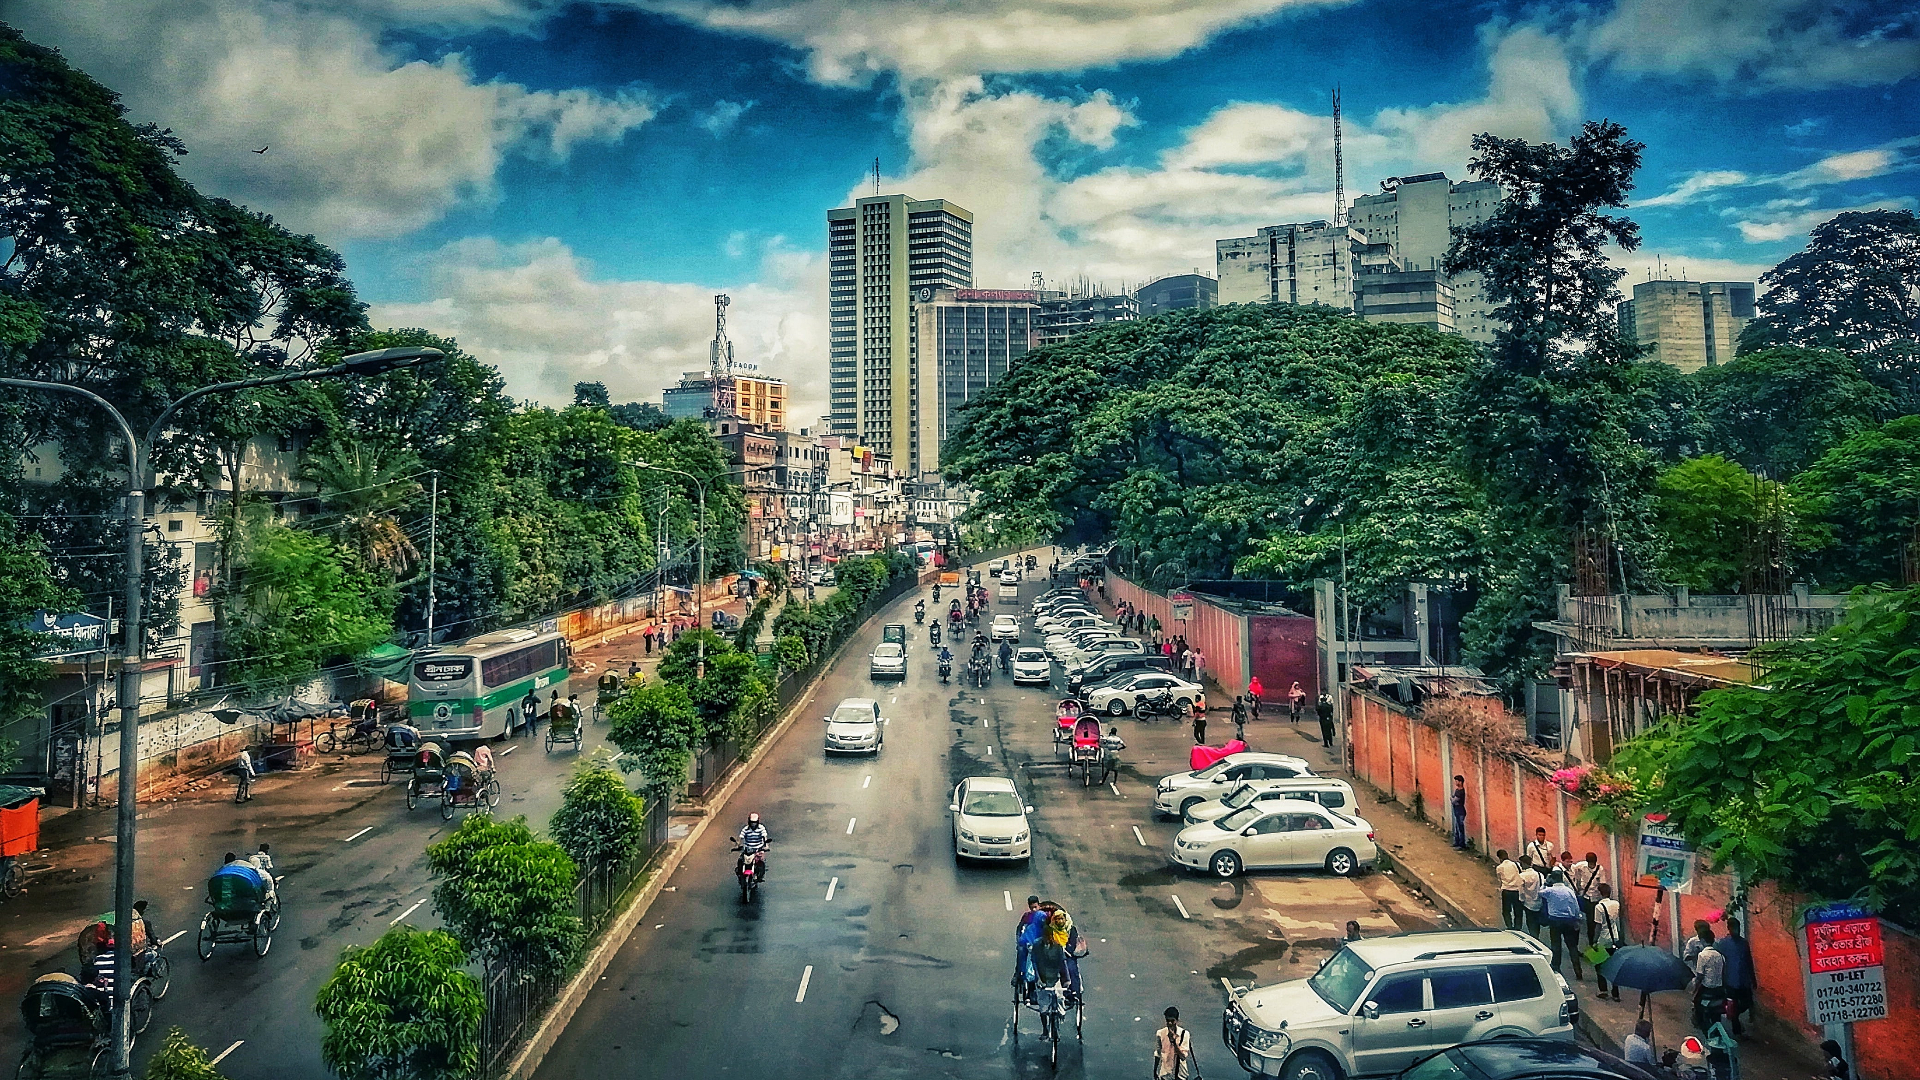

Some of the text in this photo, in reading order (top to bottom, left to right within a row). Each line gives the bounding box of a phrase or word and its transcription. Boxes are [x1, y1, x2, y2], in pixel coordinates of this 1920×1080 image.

[1842, 921, 1872, 935] এড়াতে
[1831, 938, 1854, 950] ওভার
[1815, 955, 1845, 968] ব্যবহার
[1830, 970, 1866, 983] TO-LET
[1817, 982, 1881, 998] 01740-340722
[1818, 994, 1884, 1010] 01715-572280
[1820, 1005, 1885, 1023] 01718-122700
